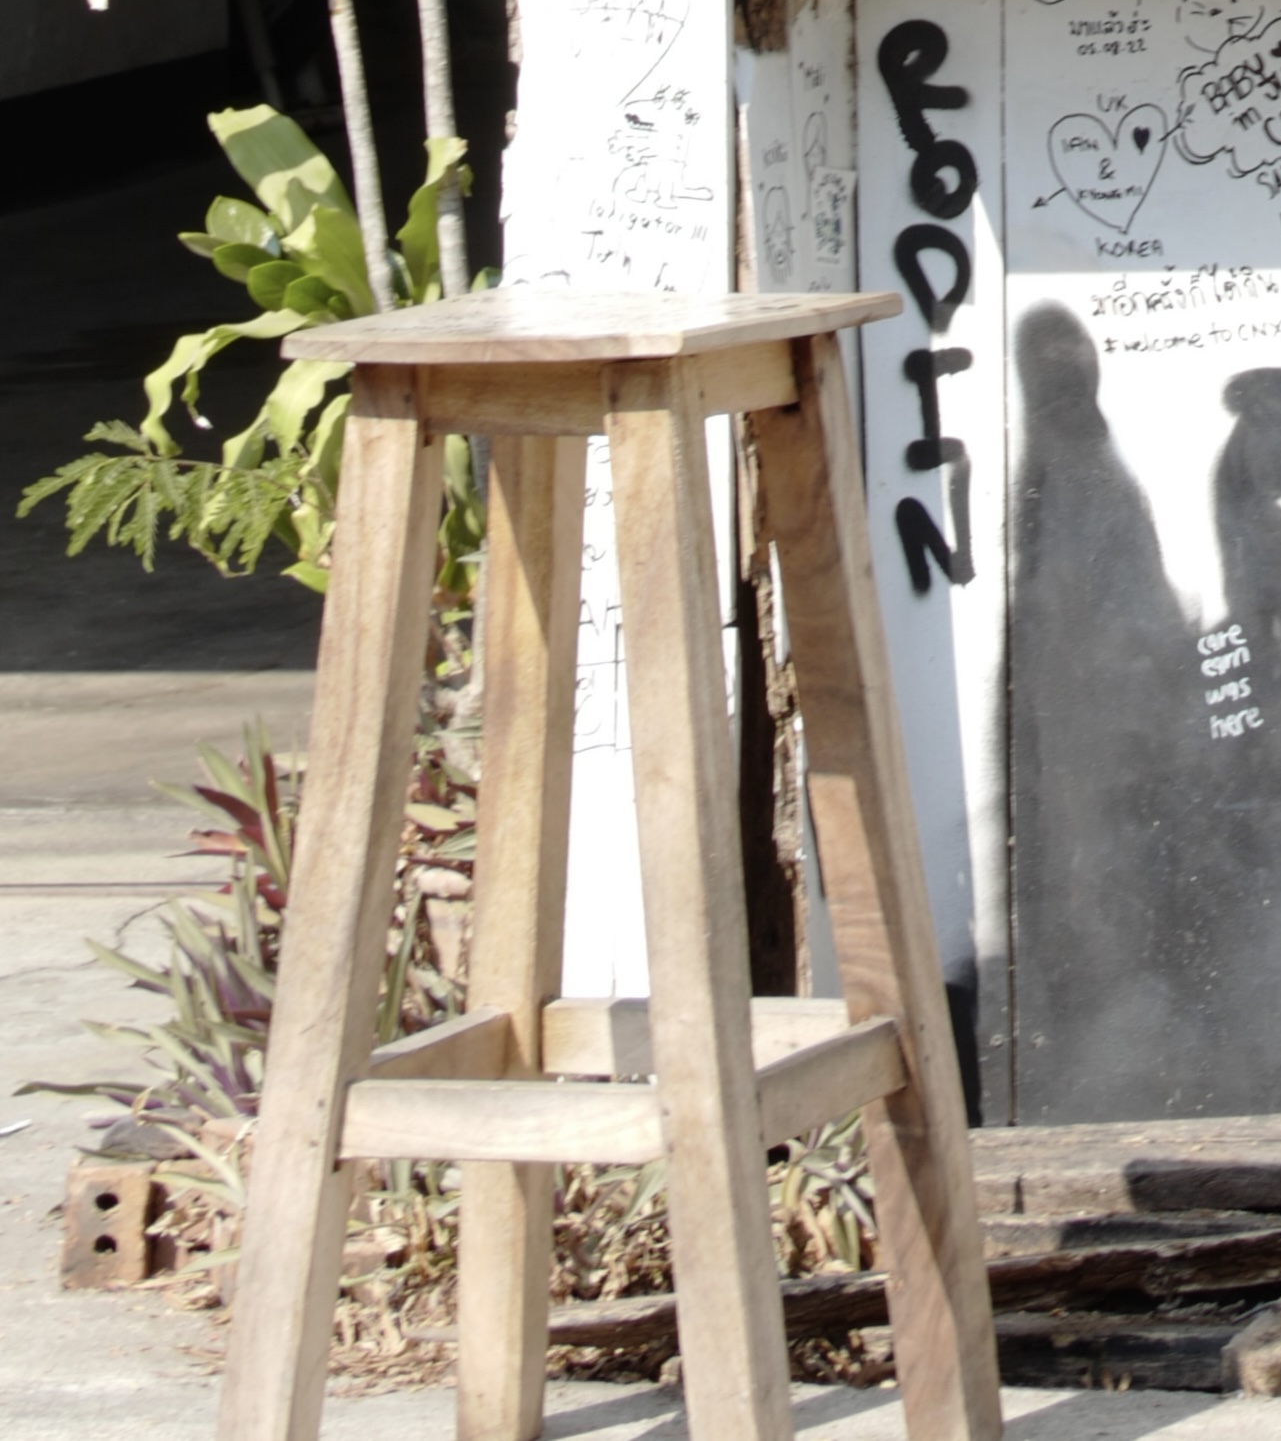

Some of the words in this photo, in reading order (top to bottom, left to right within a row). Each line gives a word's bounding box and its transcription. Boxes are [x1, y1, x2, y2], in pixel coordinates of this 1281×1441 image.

[1201, 52, 1266, 115] BABY
[1096, 92, 1129, 114] UK
[1094, 236, 1164, 258] KOREA
[1204, 675, 1253, 707] was
[1208, 706, 1265, 740] here
